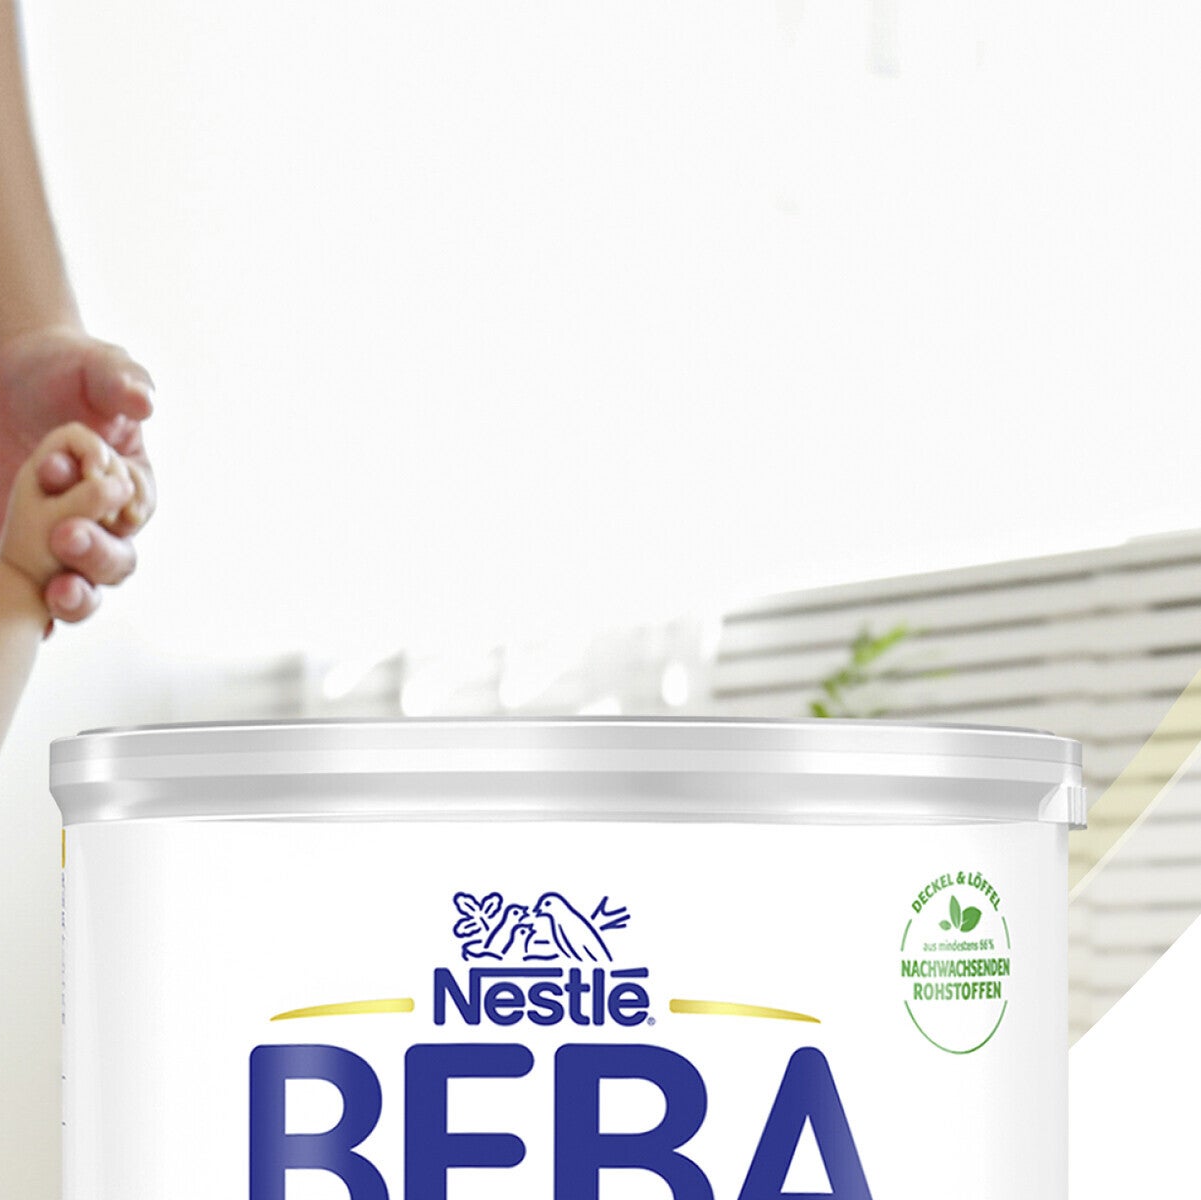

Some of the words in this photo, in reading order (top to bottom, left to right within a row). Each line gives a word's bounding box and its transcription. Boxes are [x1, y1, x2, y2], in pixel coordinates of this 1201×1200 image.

[911, 873, 953, 913] DECKEL
[956, 871, 966, 884] &
[968, 872, 1000, 912] LÖFFEL
[901, 958, 1010, 977] NACHWACHSENDEN
[432, 966, 651, 1027] Nestlé
[913, 981, 1001, 1000] ROHSTOFFEN
